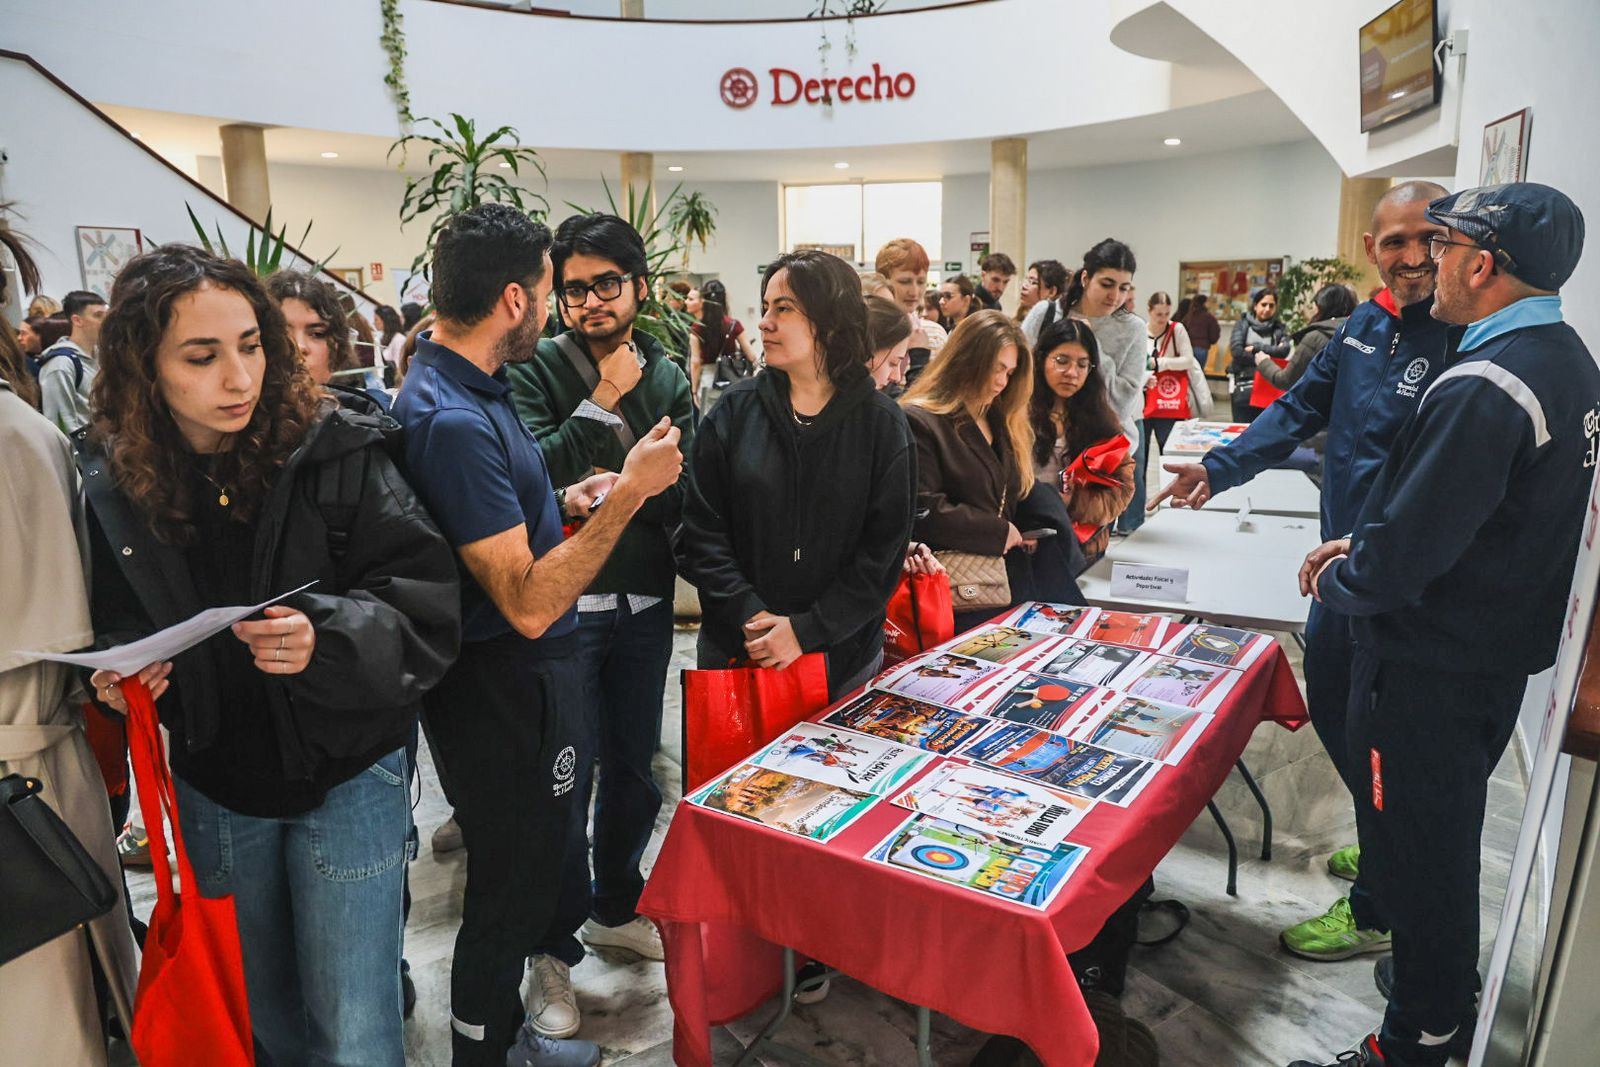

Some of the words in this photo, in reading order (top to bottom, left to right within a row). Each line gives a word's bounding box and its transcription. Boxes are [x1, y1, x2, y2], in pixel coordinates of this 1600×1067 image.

[768, 62, 916, 107] Derecho
[859, 761, 890, 782] KAYAK
[1088, 764, 1124, 786] TORNEO
[1036, 804, 1067, 823] MILLA
[1024, 821, 1051, 837] UHU
